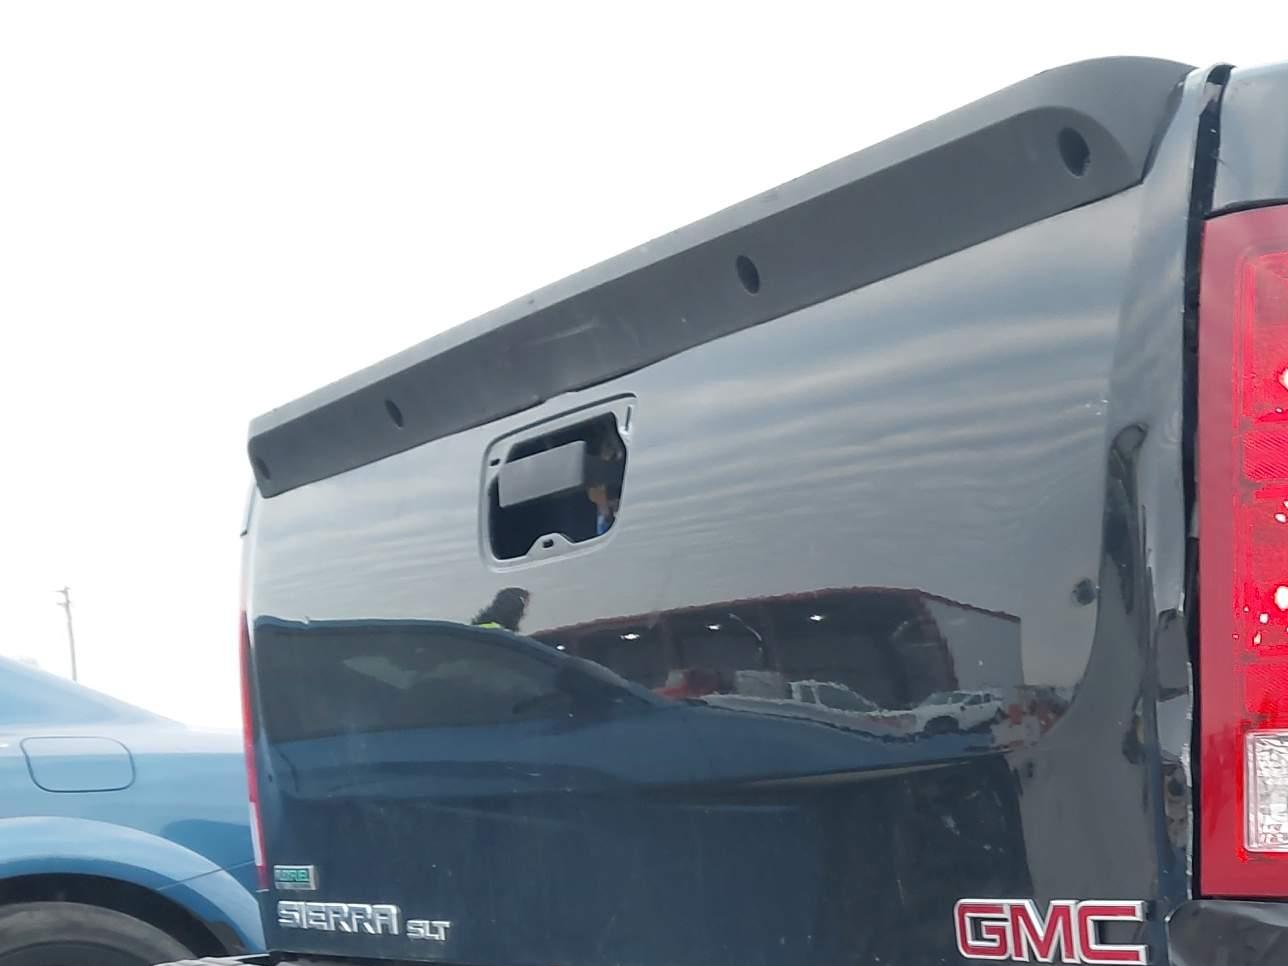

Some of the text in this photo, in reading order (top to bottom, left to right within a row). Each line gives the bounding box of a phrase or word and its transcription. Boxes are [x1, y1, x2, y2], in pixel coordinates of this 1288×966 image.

[277, 900, 452, 942] SIERRA SLT
[954, 898, 1149, 966] GMC
